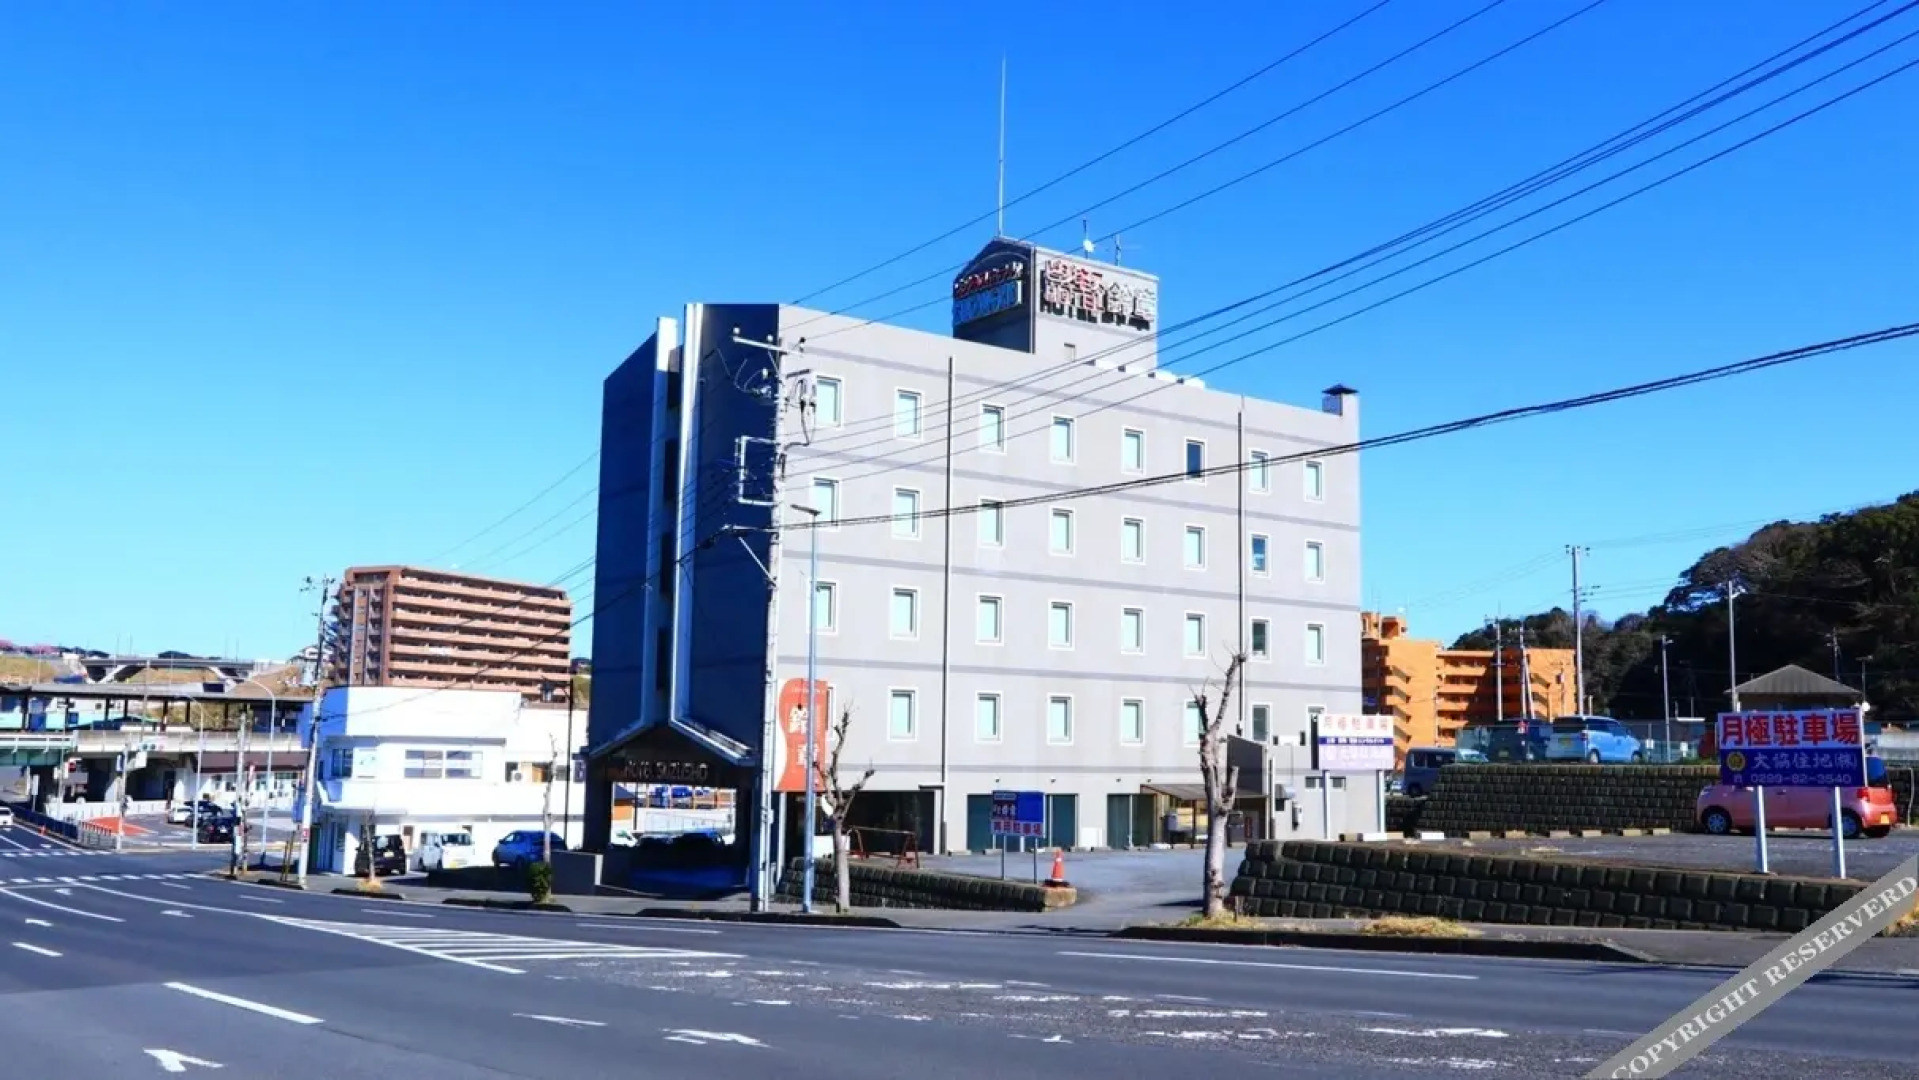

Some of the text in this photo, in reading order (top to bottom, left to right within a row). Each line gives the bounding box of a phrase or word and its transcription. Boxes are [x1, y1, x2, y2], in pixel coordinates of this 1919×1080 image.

[1721, 712, 1860, 745] 月極駐車場
